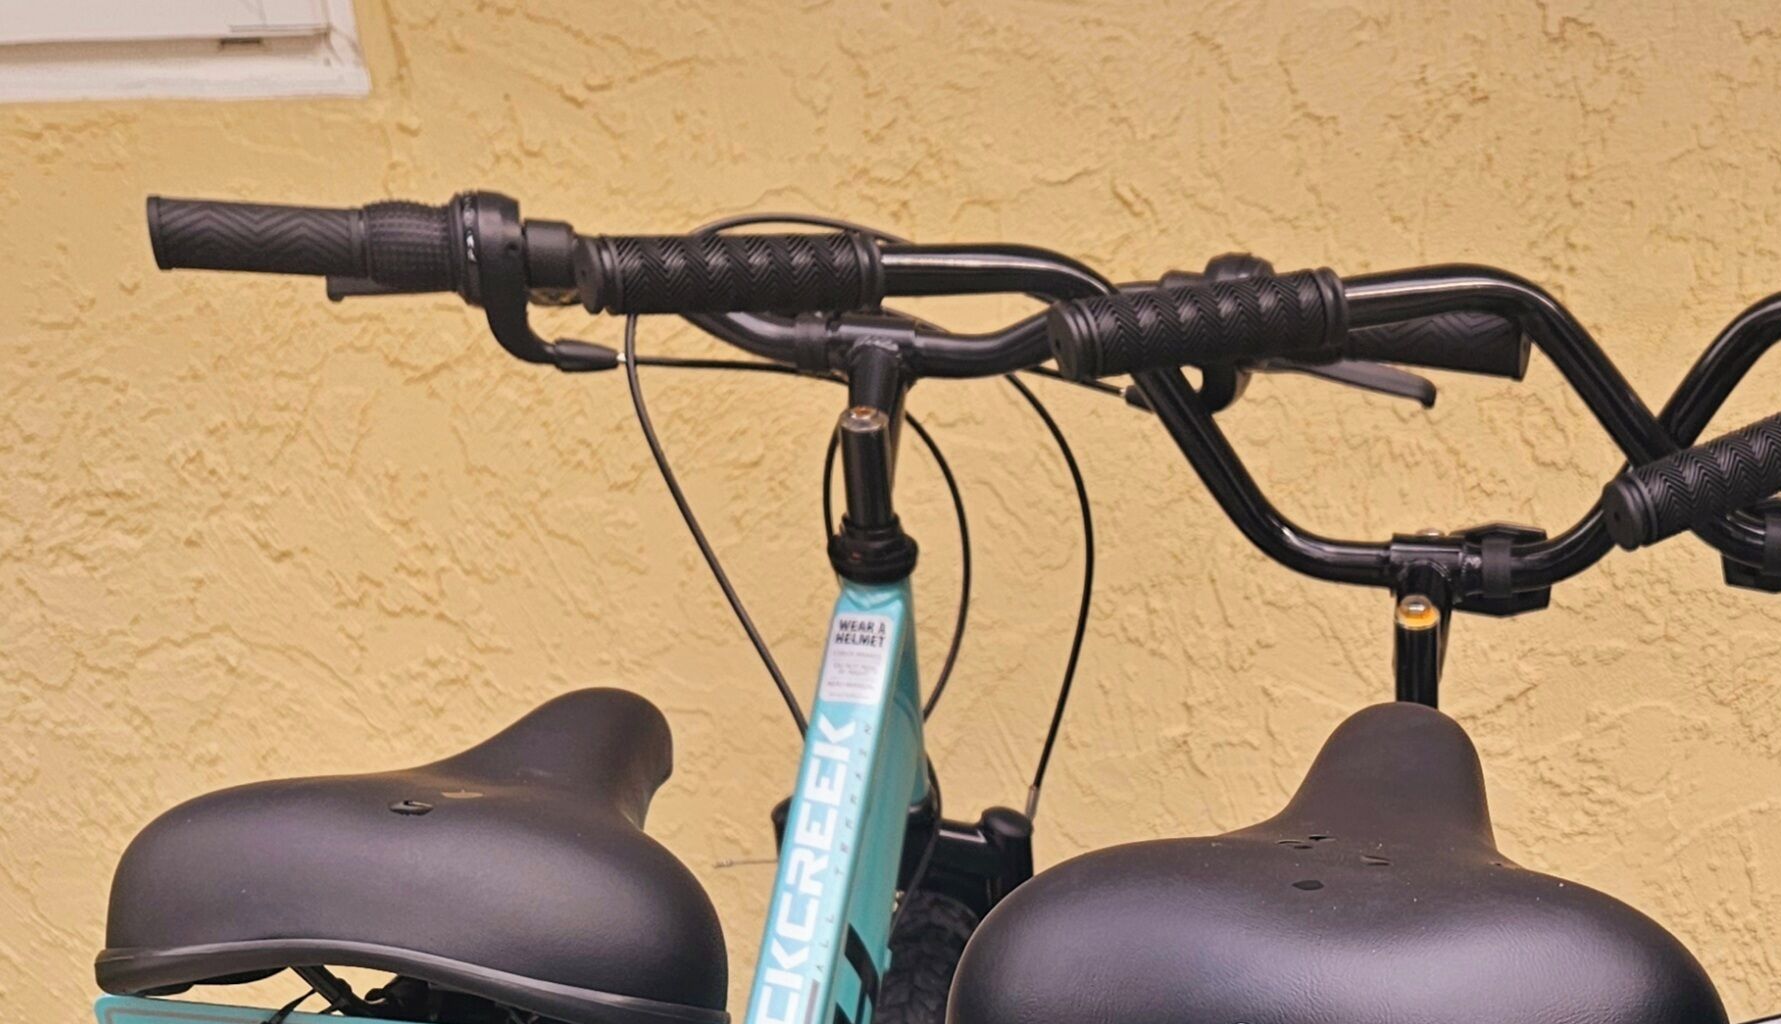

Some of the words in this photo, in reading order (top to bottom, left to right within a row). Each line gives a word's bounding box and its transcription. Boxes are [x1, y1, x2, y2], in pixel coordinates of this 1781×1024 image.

[839, 619, 875, 633] WEAR
[878, 622, 887, 635] A
[835, 632, 886, 648] HELMET
